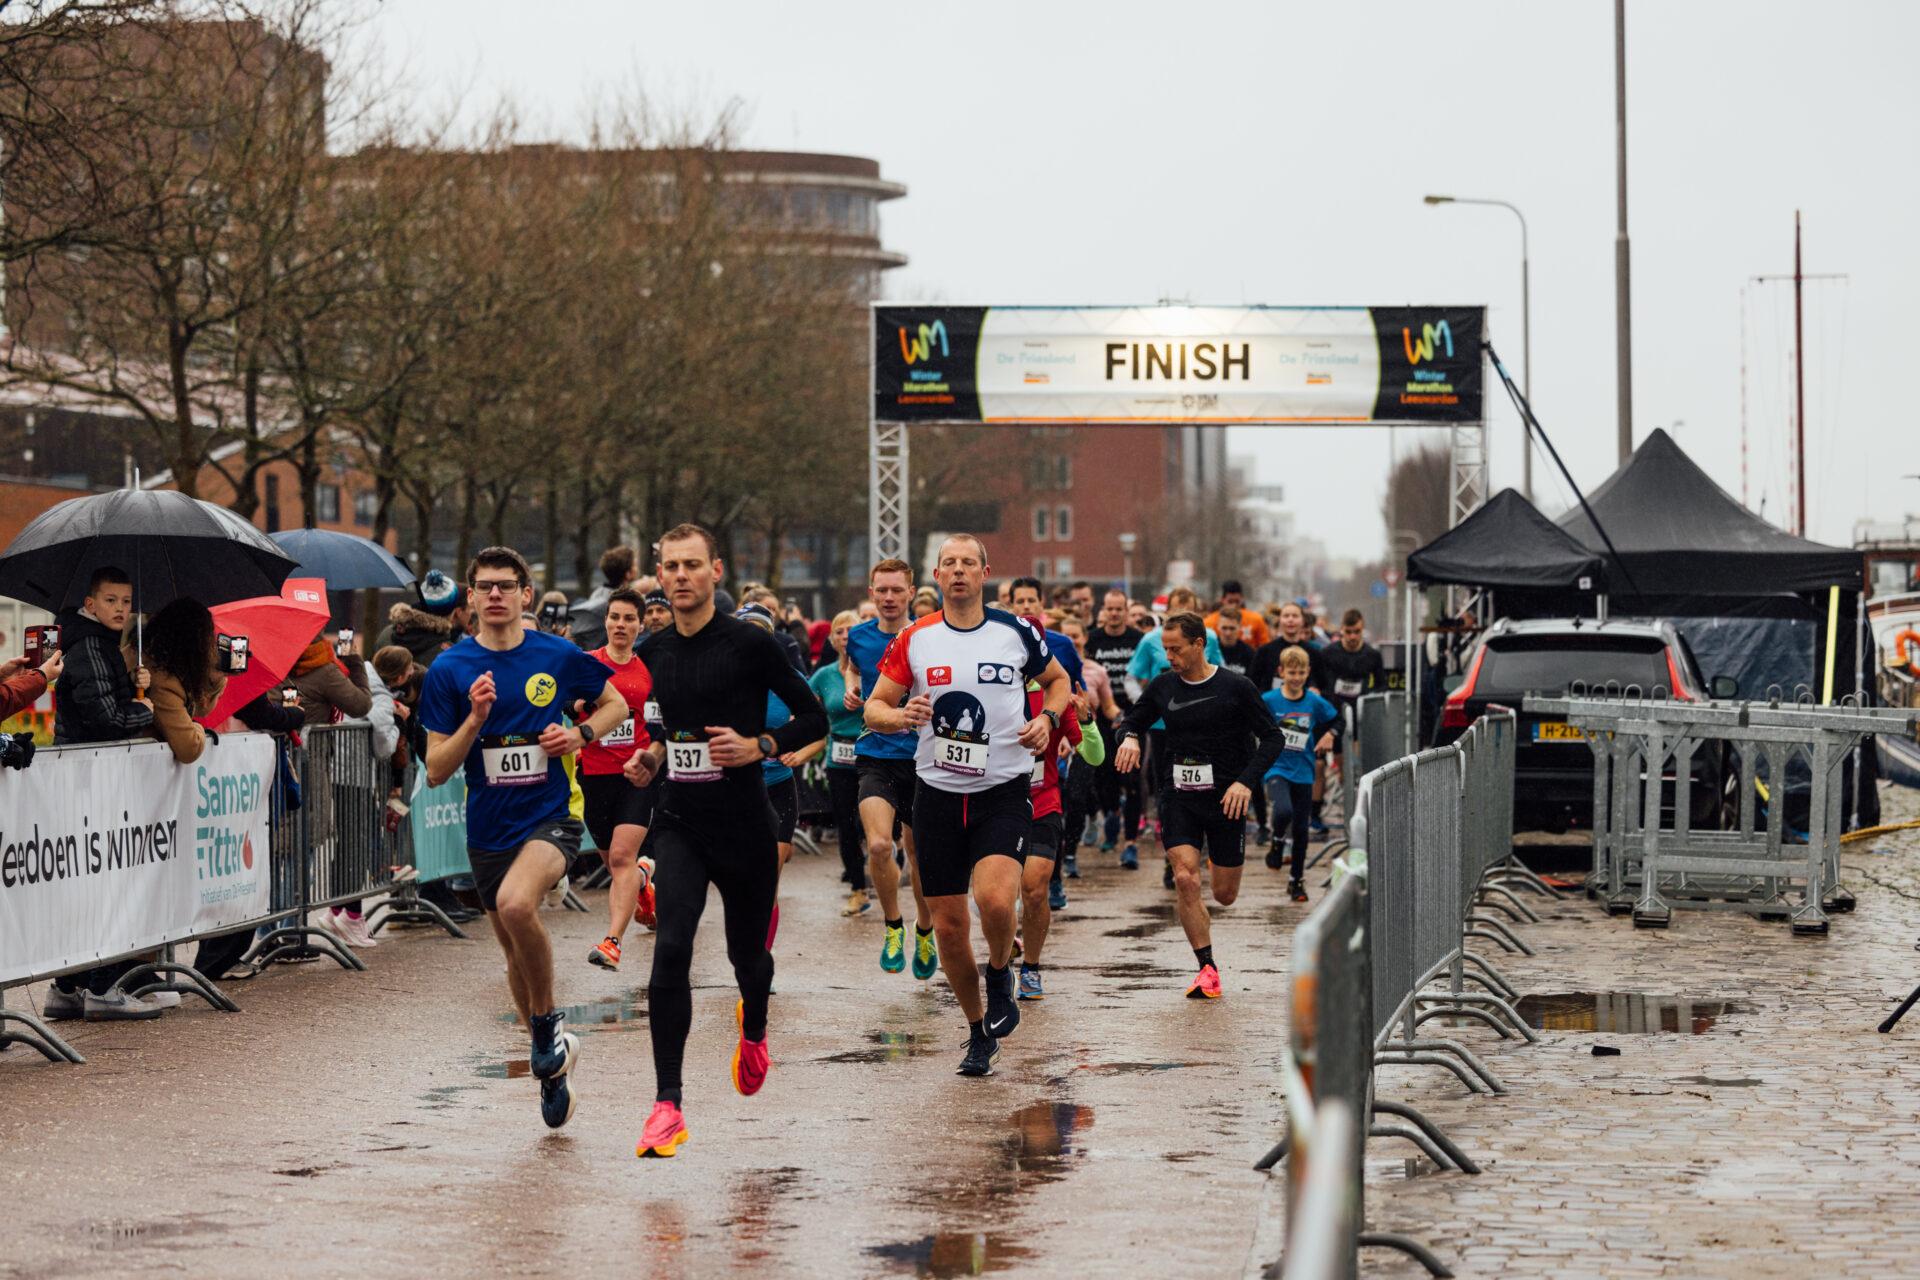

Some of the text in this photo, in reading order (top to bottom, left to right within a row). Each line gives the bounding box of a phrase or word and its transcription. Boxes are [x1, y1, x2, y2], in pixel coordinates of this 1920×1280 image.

[1106, 343, 1250, 380] FINISH
[501, 752, 530, 773] 601
[674, 749, 701, 768] 537
[946, 744, 971, 764] 531
[1182, 769, 1201, 782] 576
[197, 765, 260, 818] Samen
[0, 810, 177, 888] eedoen is winnen
[197, 827, 244, 880] Fitter
